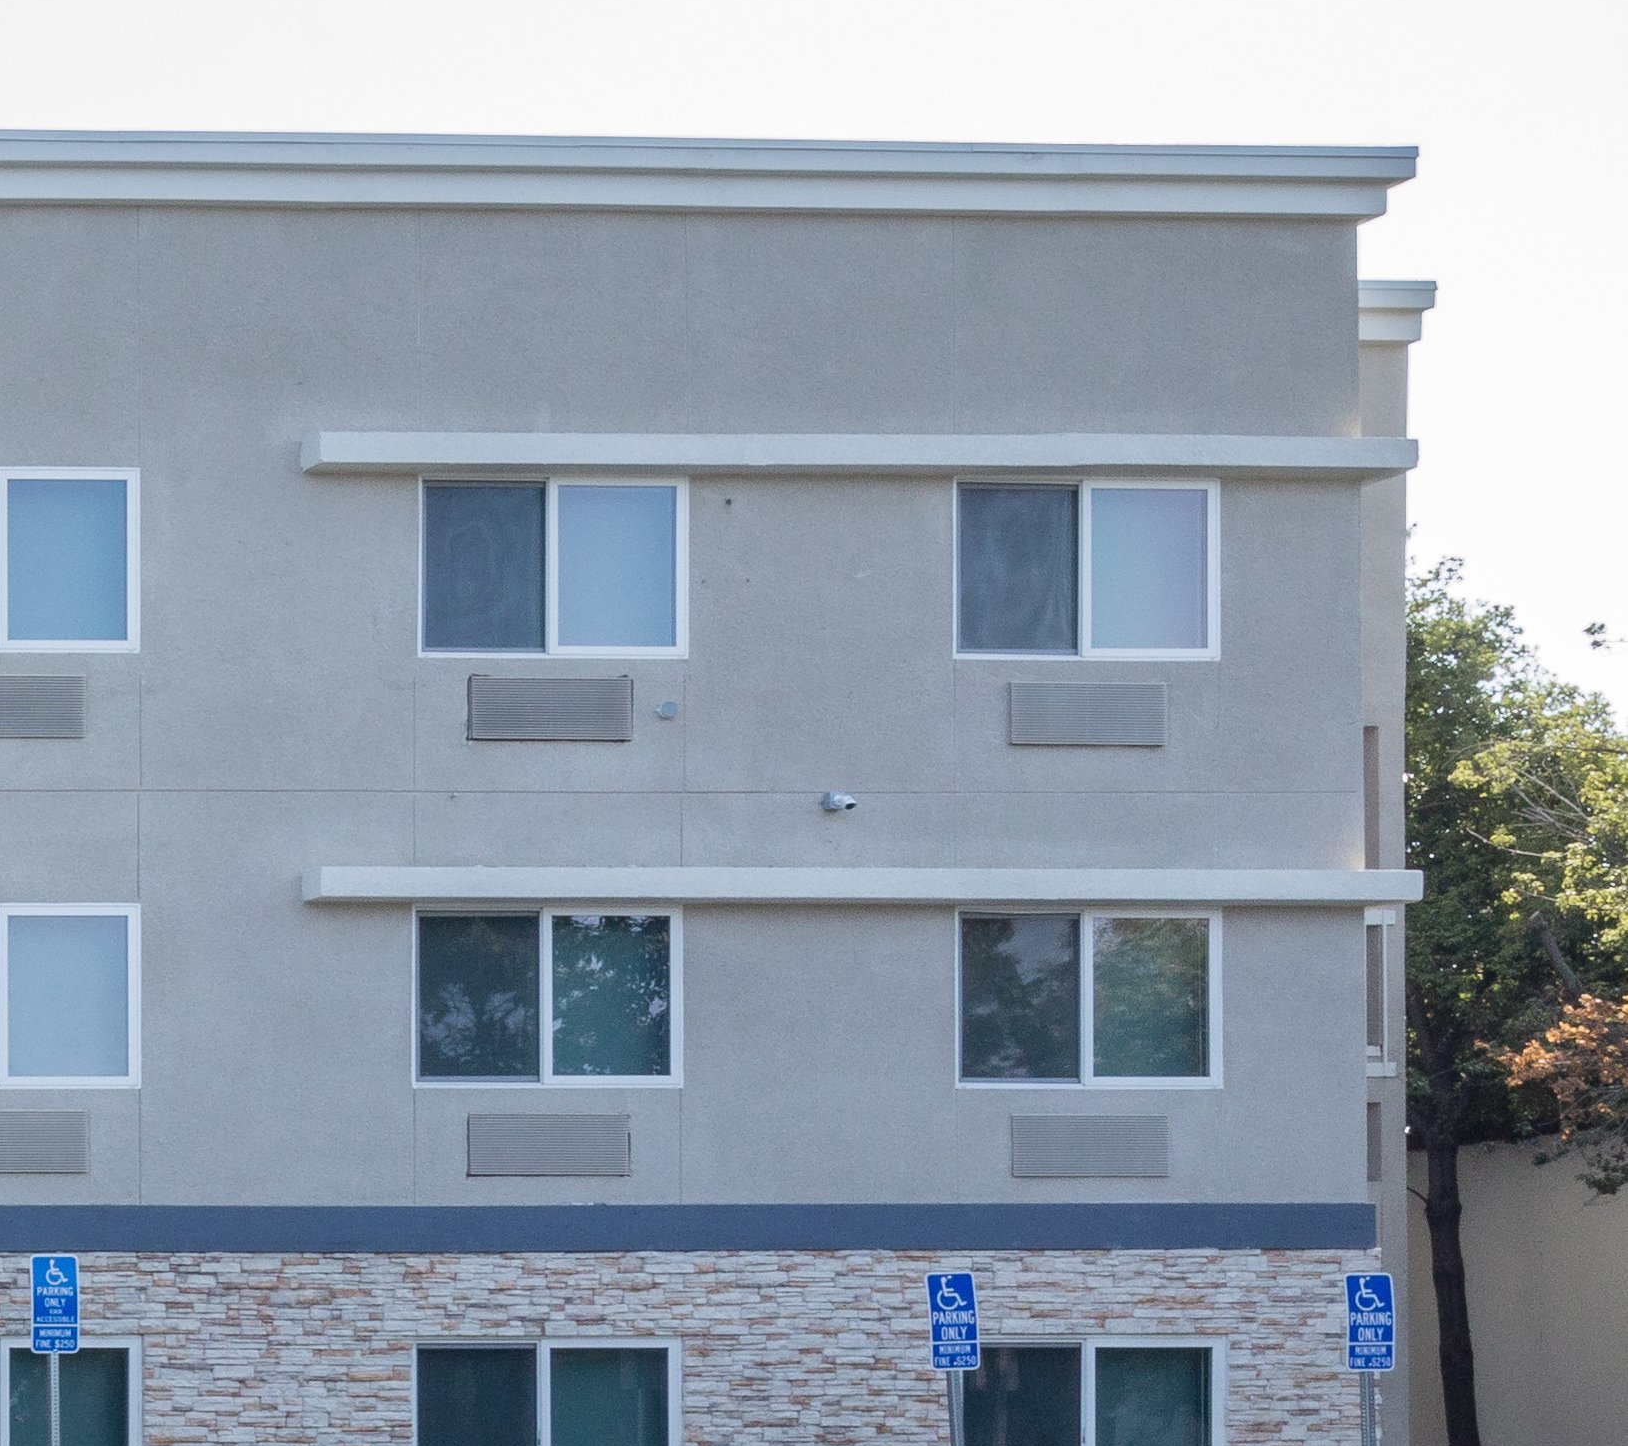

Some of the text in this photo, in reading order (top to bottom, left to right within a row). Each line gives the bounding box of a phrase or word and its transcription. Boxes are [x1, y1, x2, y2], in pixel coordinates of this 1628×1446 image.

[36, 1286, 74, 1297] PARKING
[44, 1297, 67, 1308] ONLY
[932, 1310, 975, 1325] PARKING
[1350, 1311, 1392, 1326] PARKING
[941, 1326, 968, 1341] ONLY
[1358, 1327, 1384, 1342] ONLY
